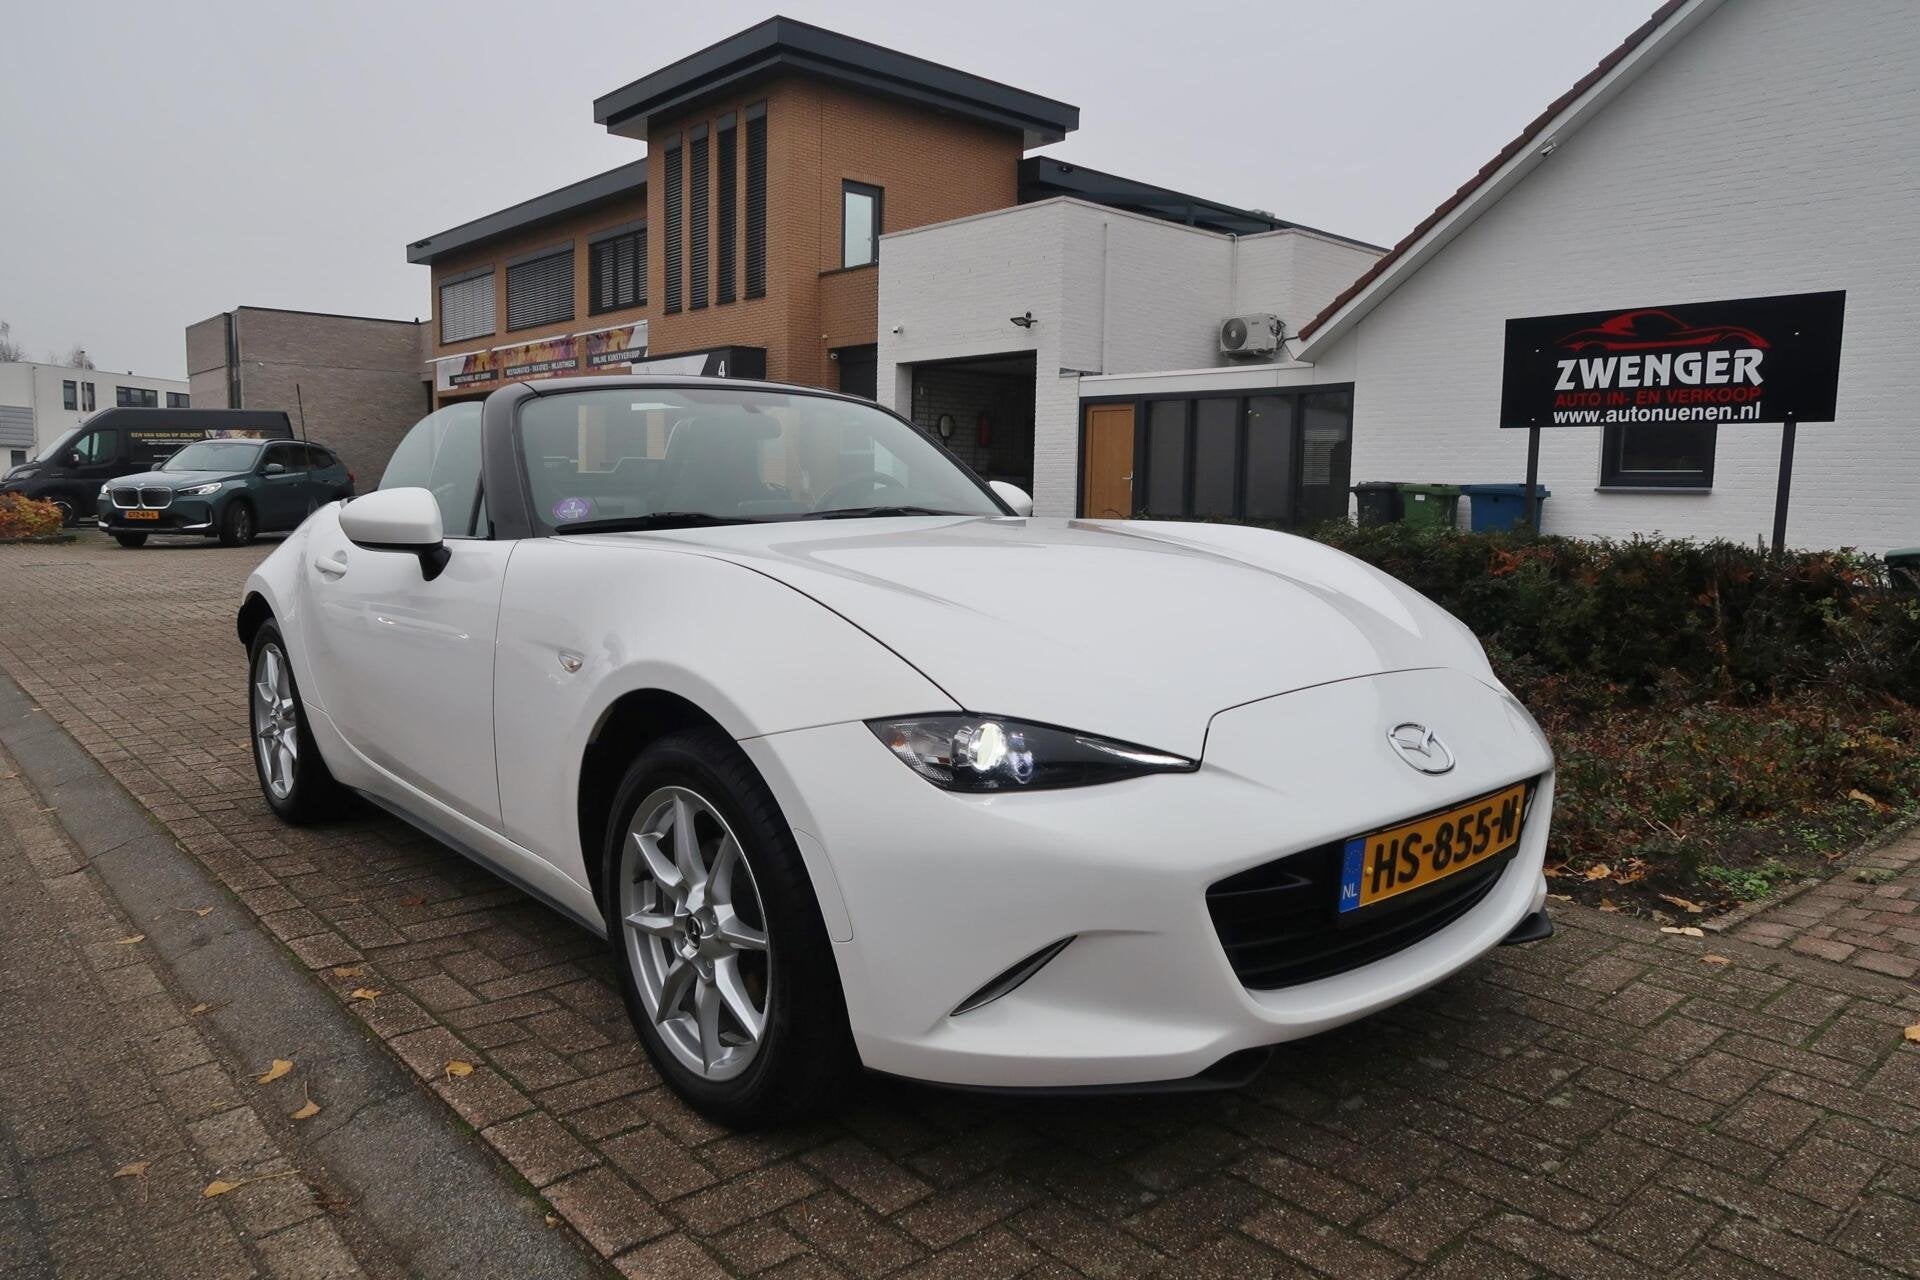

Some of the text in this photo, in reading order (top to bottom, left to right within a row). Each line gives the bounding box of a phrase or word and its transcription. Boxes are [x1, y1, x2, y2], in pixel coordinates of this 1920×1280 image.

[718, 360, 725, 378] 4
[1554, 349, 1764, 390] ZWENGER
[1555, 386, 1761, 408] AUTO IN- EN VERKOOP
[1553, 401, 1761, 424] www.autonuenen.nl
[1371, 794, 1519, 894] HS-855-N
[1342, 884, 1358, 900] NL
